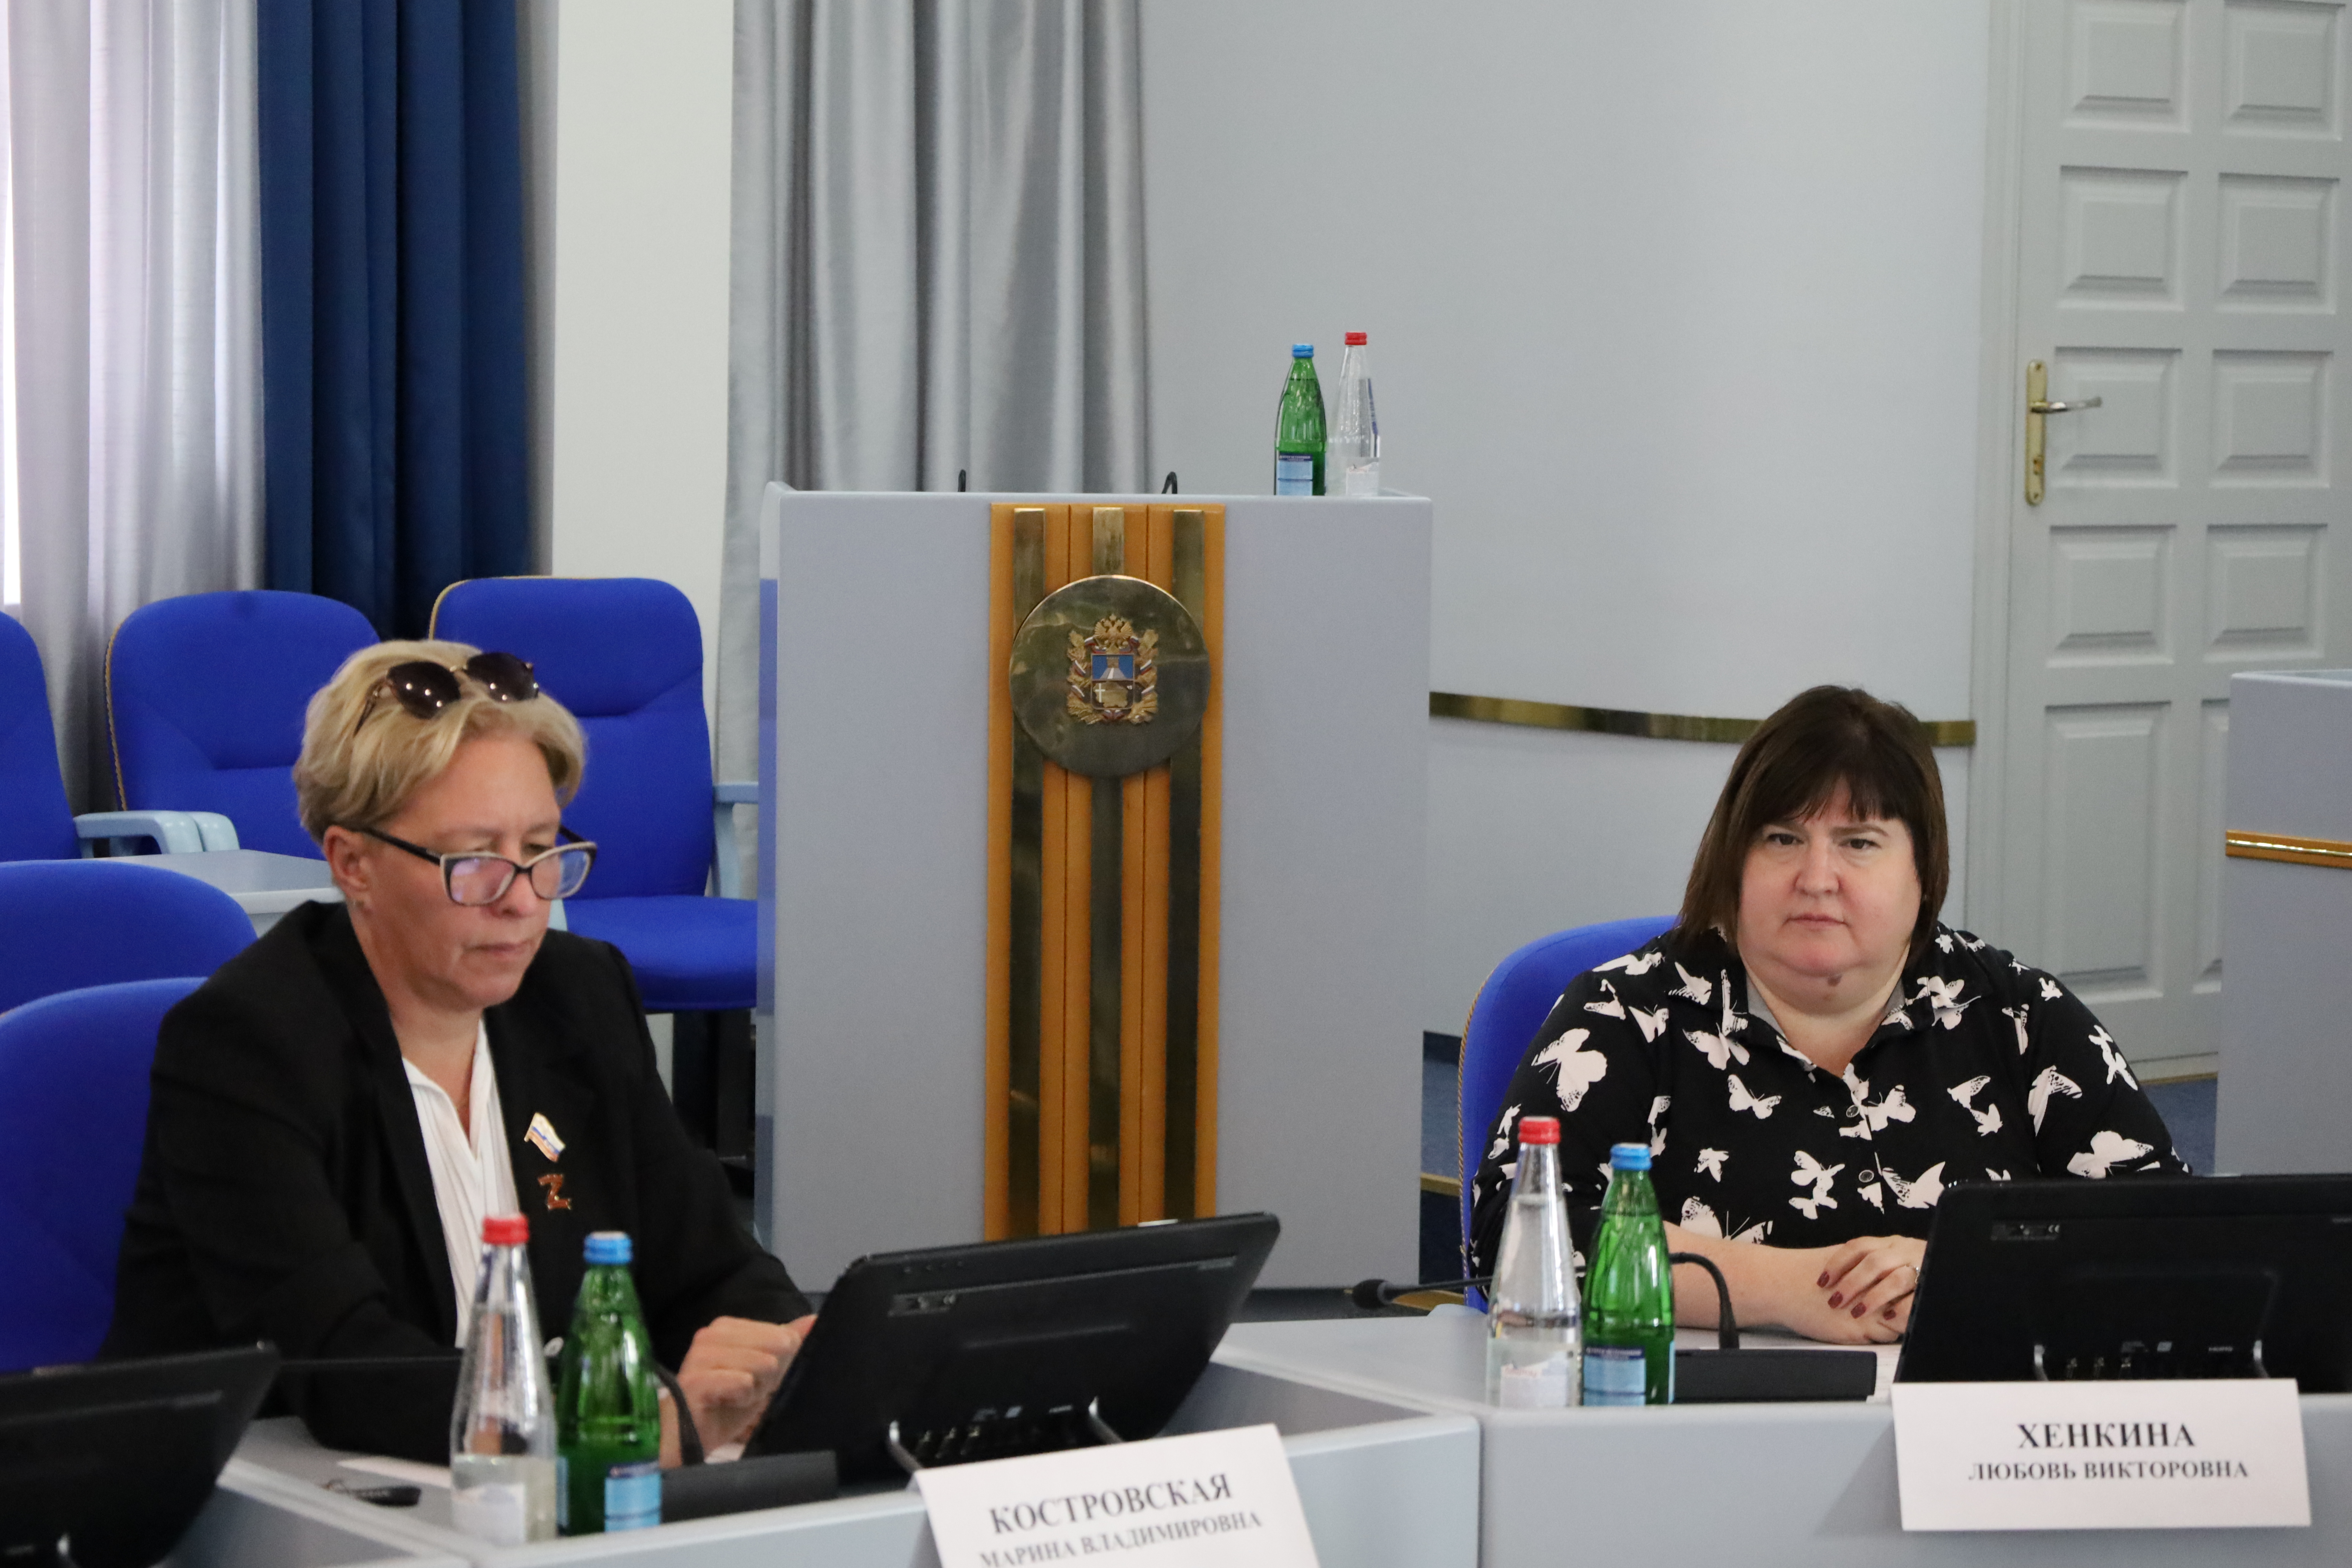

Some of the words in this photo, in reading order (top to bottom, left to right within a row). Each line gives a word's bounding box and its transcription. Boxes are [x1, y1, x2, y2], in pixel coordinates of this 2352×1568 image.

[537, 1173, 572, 1211] Z
[2017, 1422, 2196, 1449] ХЕНКИНА
[1969, 1462, 2076, 1481] ЛЮБОВЬ
[2084, 1460, 2249, 1480] ВИКТОРОВНА
[989, 1473, 1233, 1534] КОСТРОВСКАЯ
[980, 1541, 1076, 1568] МАРИНА
[1081, 1511, 1262, 1554] ВЛАДИМИРОВНА
